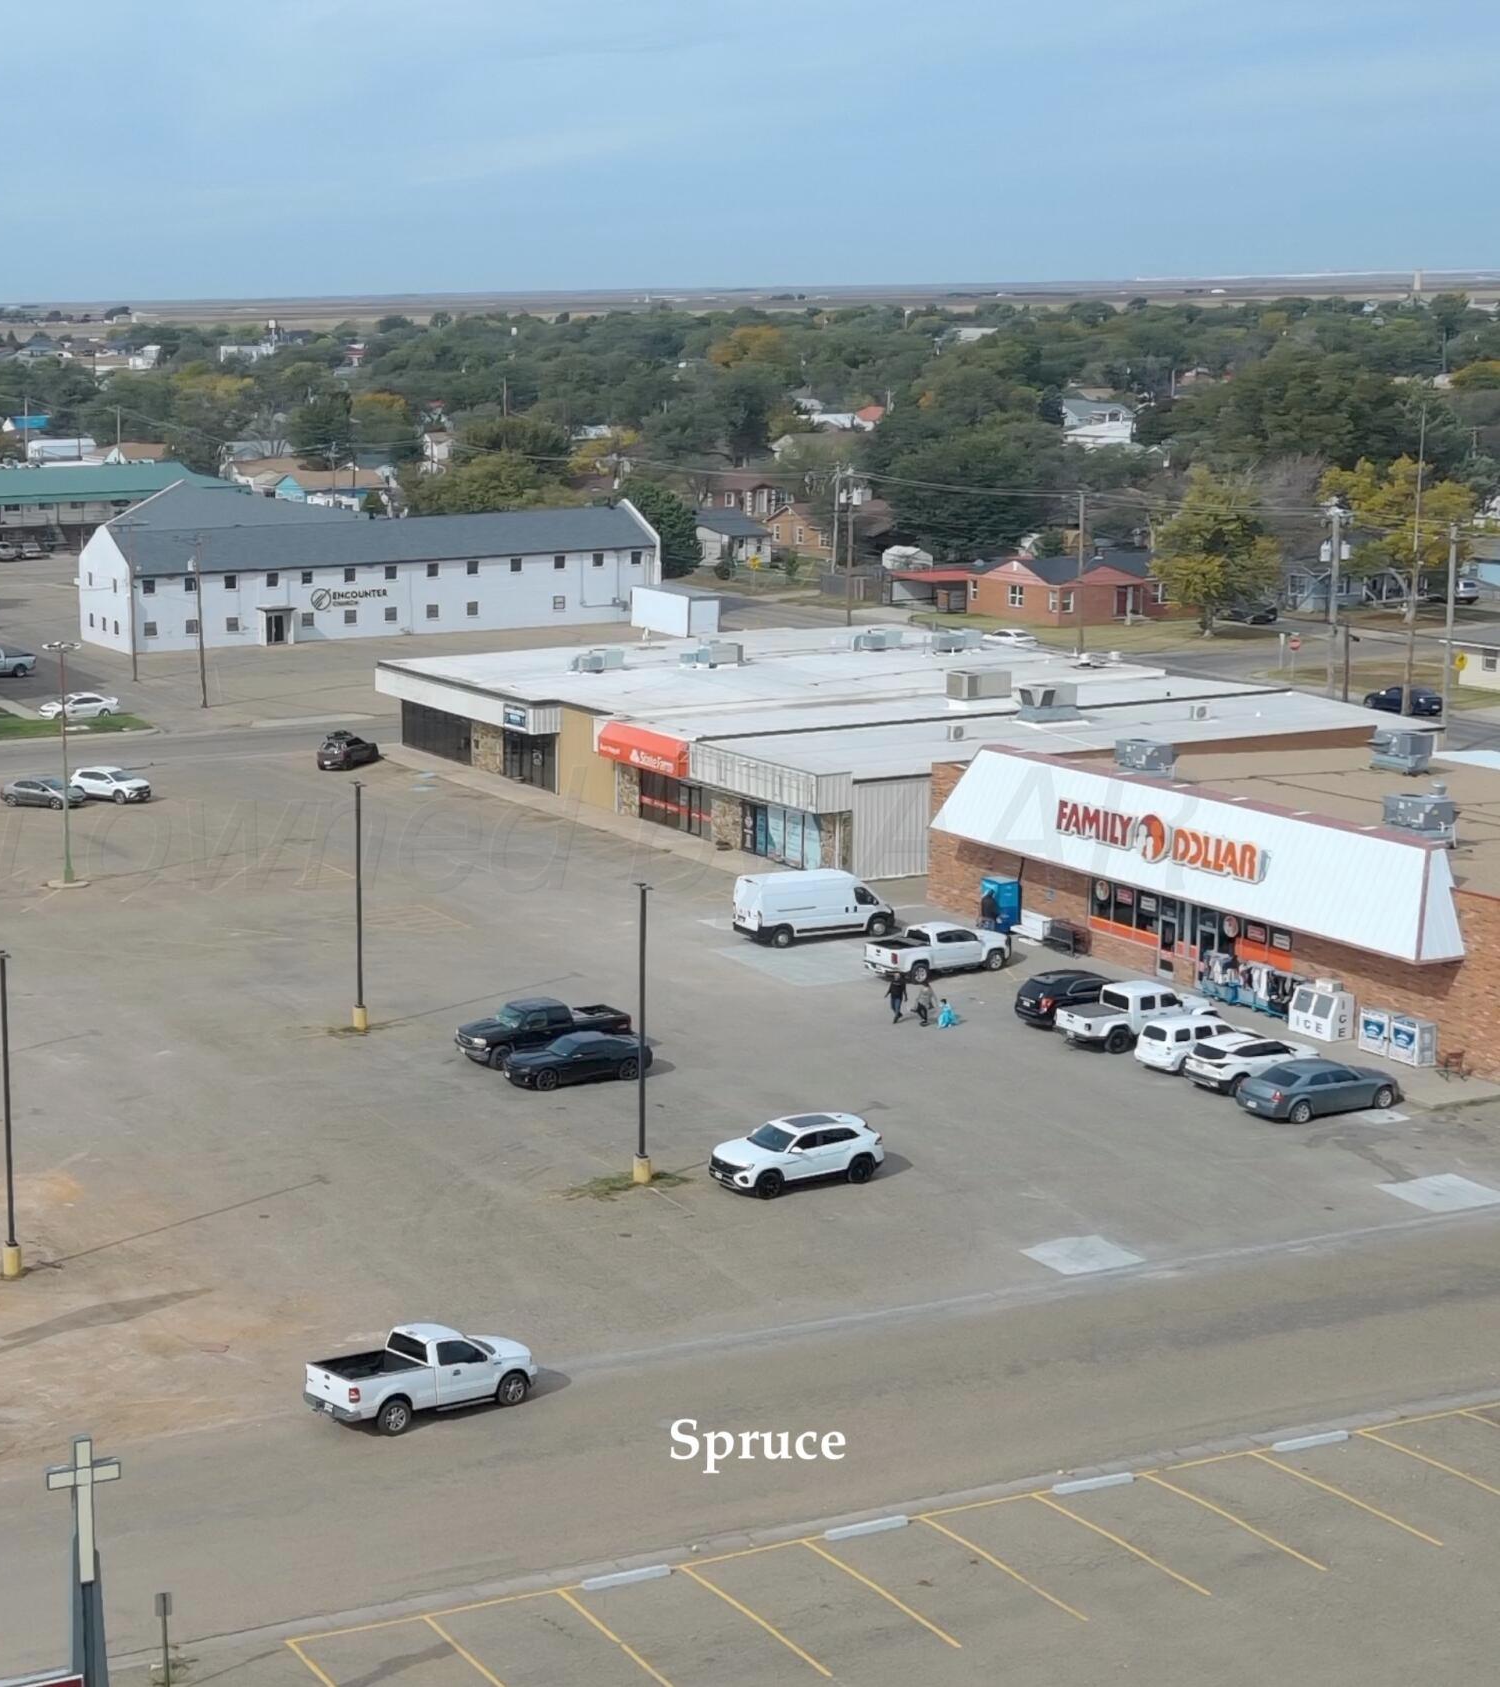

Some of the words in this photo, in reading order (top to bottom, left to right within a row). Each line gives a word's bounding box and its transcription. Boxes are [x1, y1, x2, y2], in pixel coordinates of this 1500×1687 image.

[332, 588, 388, 600] ENCOUNTER
[1054, 798, 1136, 850] FAMILY
[1171, 827, 1263, 884] DOLLAR
[1296, 1015, 1324, 1034] ICE
[1337, 999, 1348, 1038] ICE
